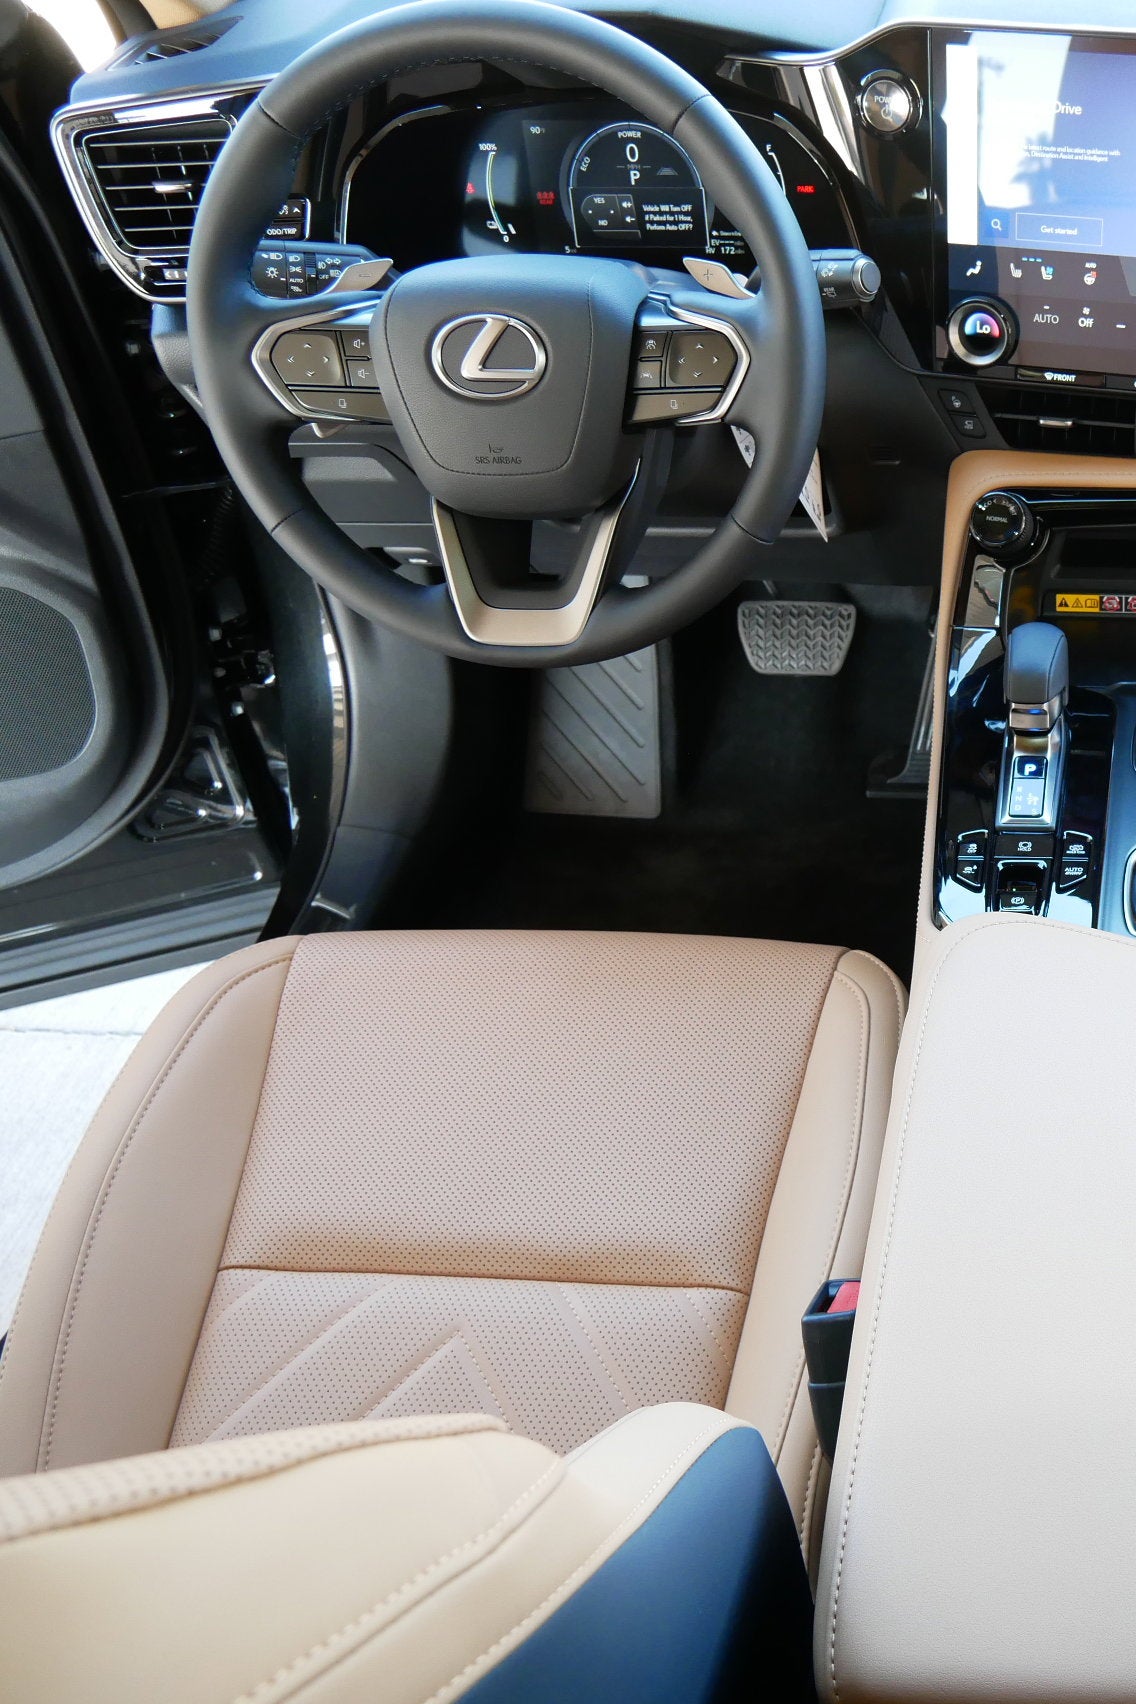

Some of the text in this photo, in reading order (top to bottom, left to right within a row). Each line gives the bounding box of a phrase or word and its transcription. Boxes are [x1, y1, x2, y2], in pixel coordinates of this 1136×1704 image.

[479, 143, 498, 151] 100%
[626, 144, 639, 162] 0
[580, 156, 591, 172] ECO
[630, 170, 640, 186] P
[1055, 227, 1077, 235] started
[1034, 314, 1059, 324] AUTO
[1078, 317, 1094, 328] Off
[976, 320, 991, 334] Lo
[1054, 373, 1076, 382] FRONT
[1024, 764, 1036, 775] P
